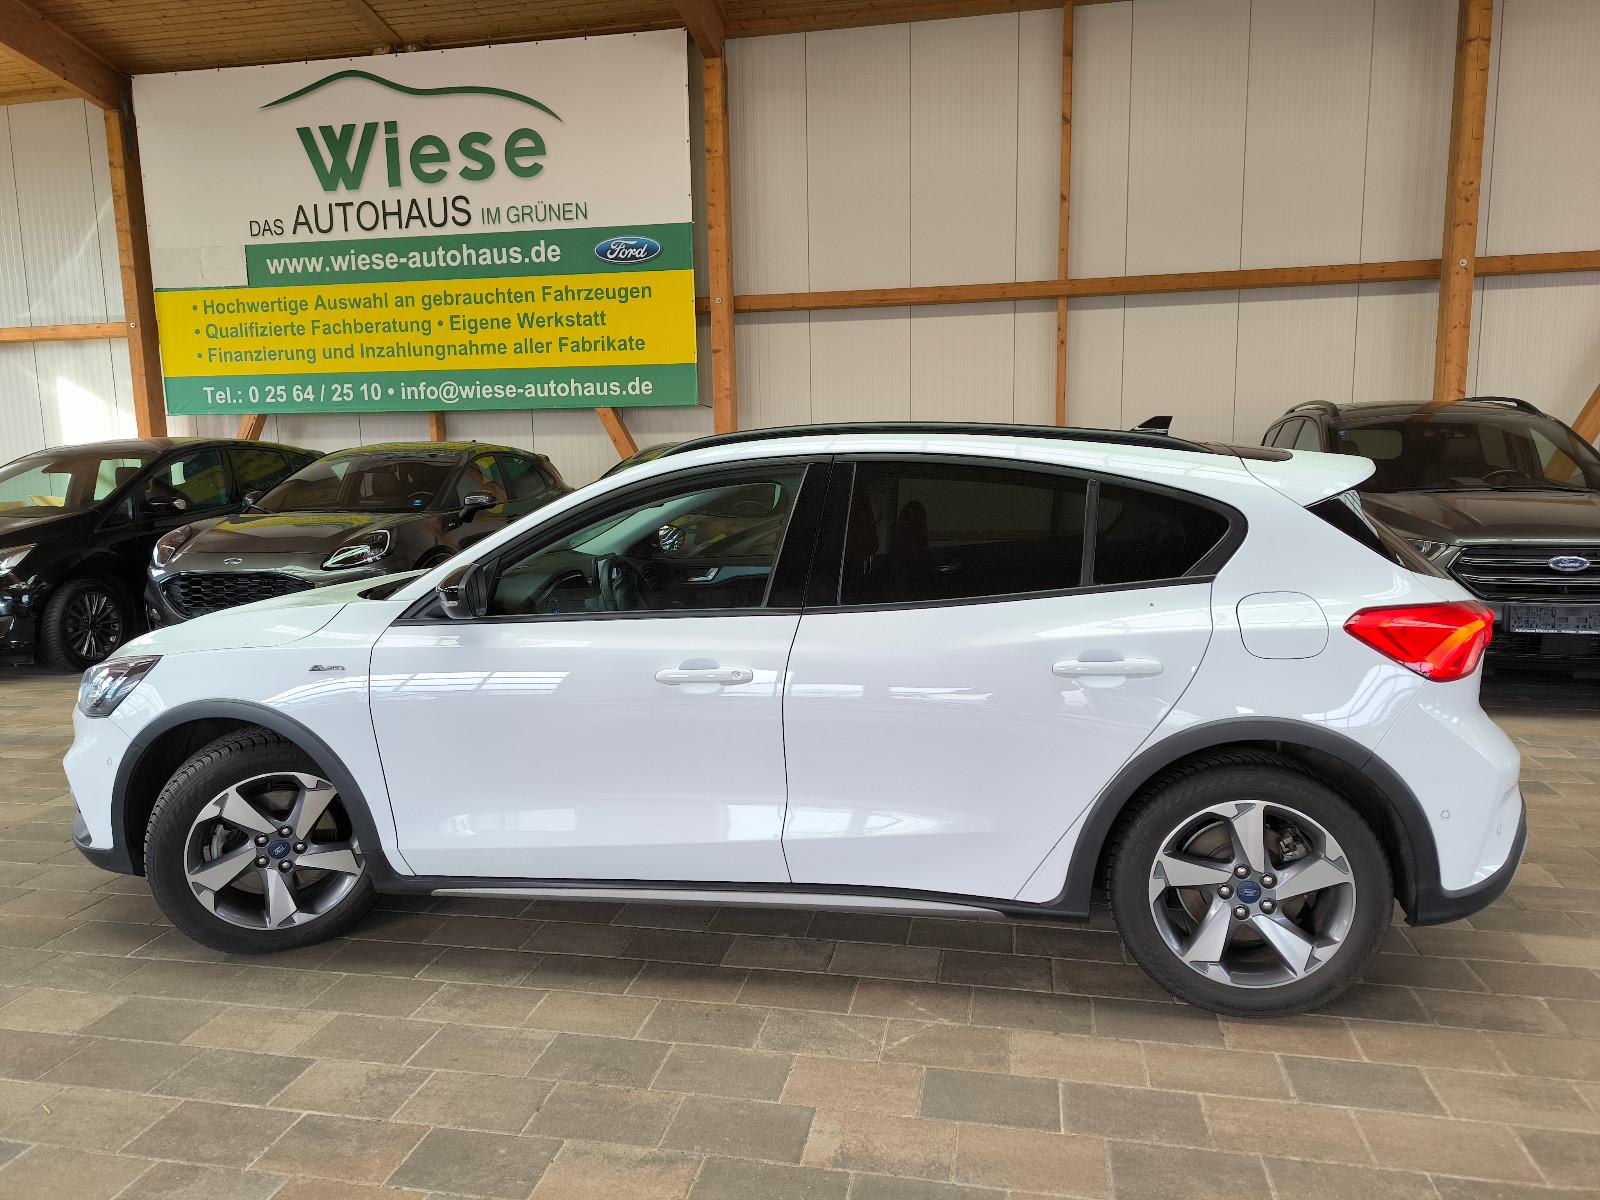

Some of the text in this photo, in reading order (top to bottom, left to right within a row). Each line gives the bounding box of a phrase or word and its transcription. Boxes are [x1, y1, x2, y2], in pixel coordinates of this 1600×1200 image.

[296, 120, 547, 191] Wiese
[249, 195, 588, 237] DAS AUTOHAUS IM GRÜNEN
[266, 240, 561, 275] www.wiese-autohaus.de
[606, 238, 648, 259] Ford
[203, 284, 652, 315] Hochwertige Auswahl an gebrauchten Fahrzeugen
[205, 311, 606, 339] Qualifizierte Fachberatung Eigene Werkstatt
[208, 335, 646, 364] Finanzierung und Inzahlungnahme aller Fabrikate
[203, 386, 243, 404] Tel.:
[248, 386, 259, 403] 0
[264, 385, 287, 402] 25
[292, 384, 315, 402] 64
[331, 383, 353, 401] 25
[360, 383, 382, 400] 10
[401, 377, 653, 404] info@wiese-autohaus.de
